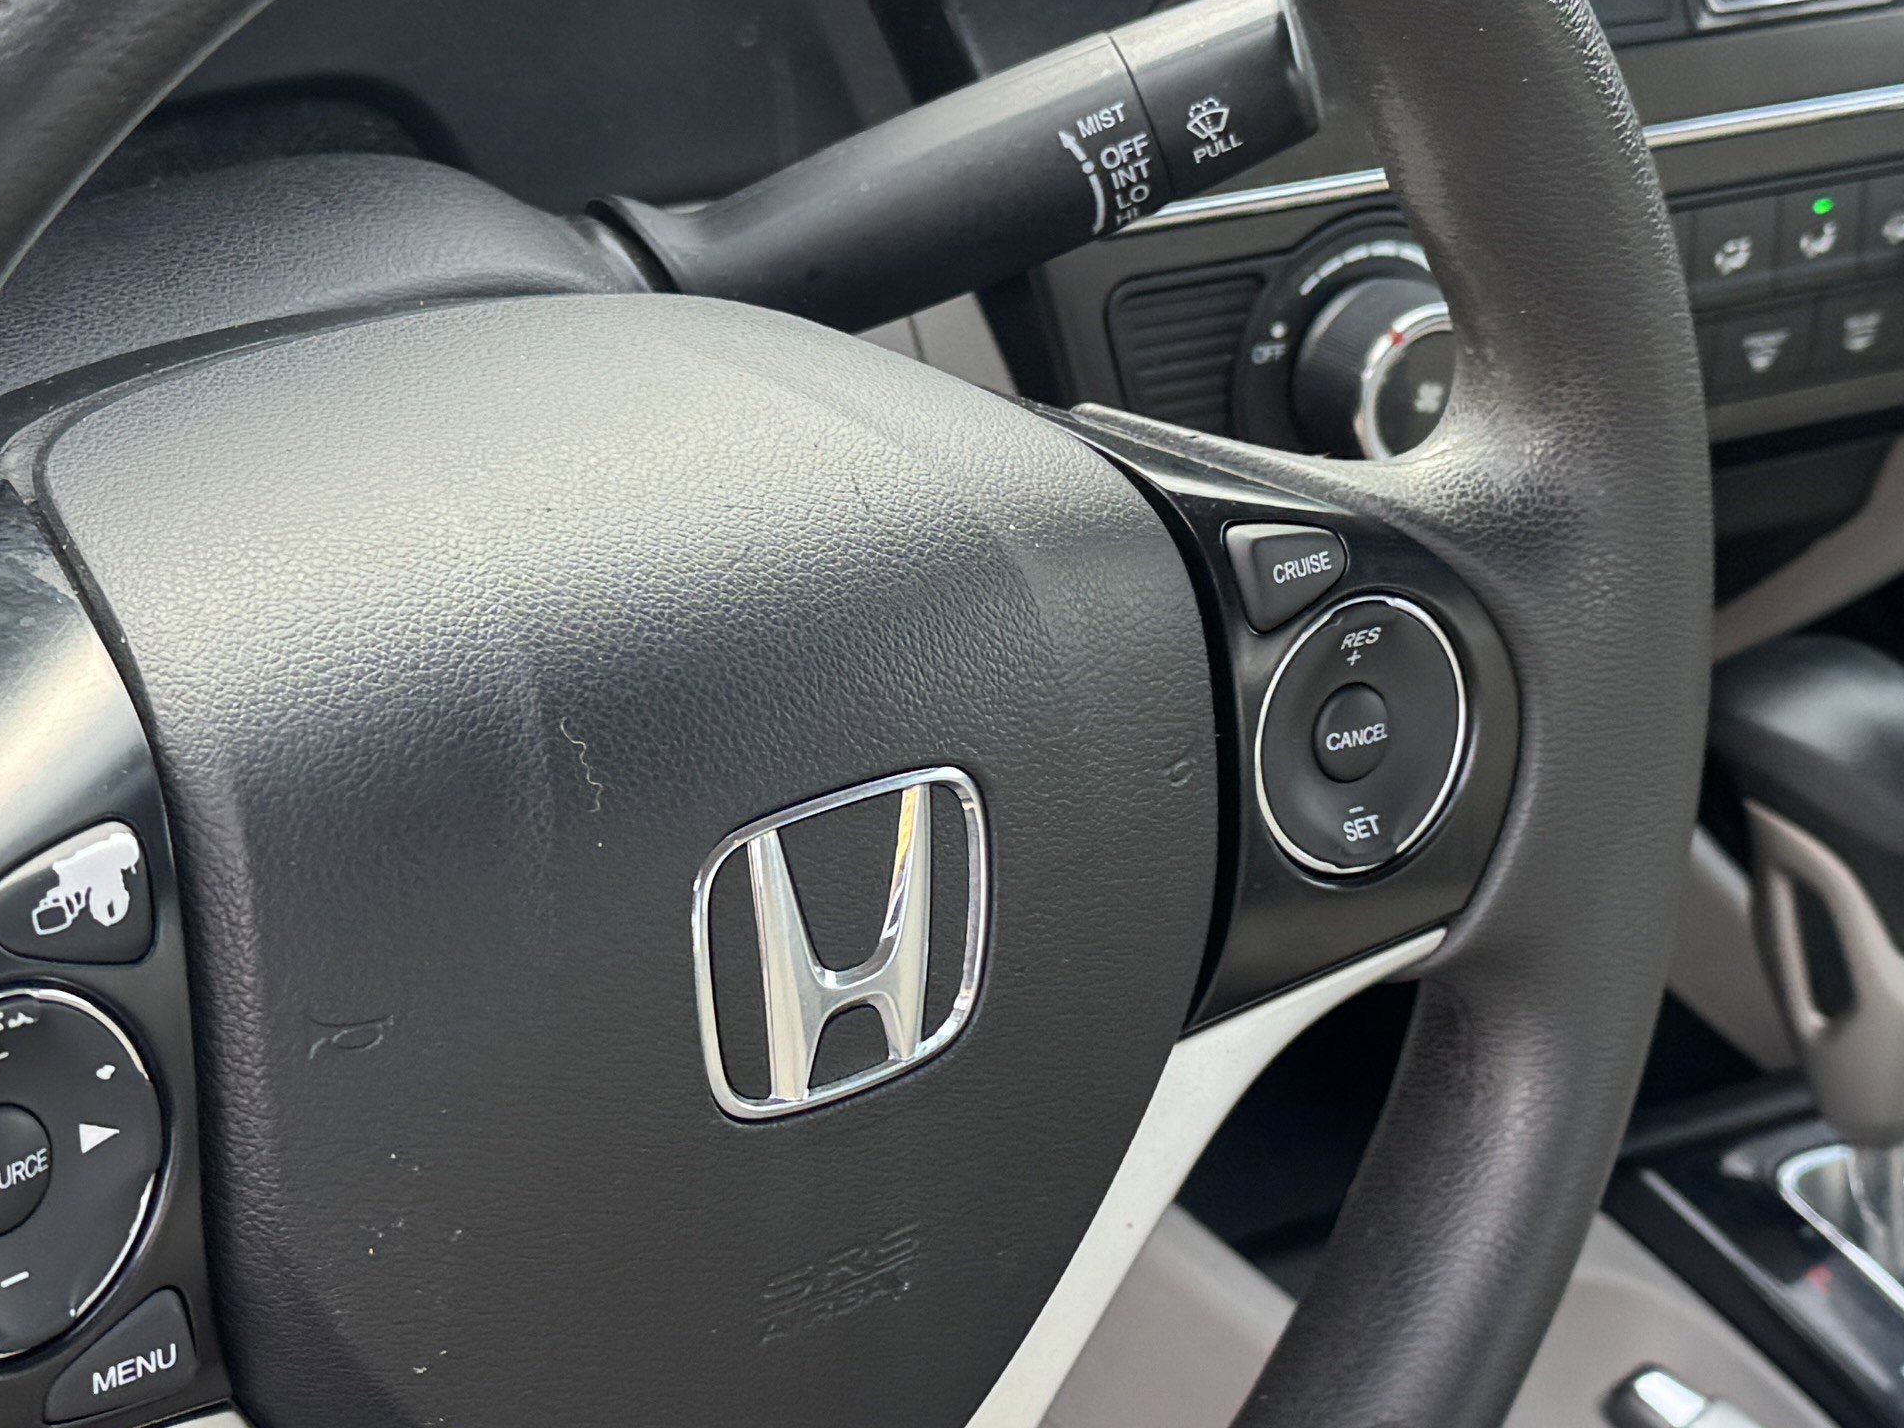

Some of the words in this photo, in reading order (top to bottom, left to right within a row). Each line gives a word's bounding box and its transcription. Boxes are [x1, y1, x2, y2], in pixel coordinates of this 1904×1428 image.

[1076, 101, 1126, 139] MIST
[1100, 132, 1149, 170] OFF
[1193, 133, 1245, 164] PULL
[1110, 158, 1151, 190] INT
[1115, 184, 1150, 210] LO
[1251, 342, 1287, 365] OFF
[1272, 551, 1332, 584] CRUISE
[1340, 627, 1382, 650] RES
[1325, 723, 1387, 752] CANCEL
[1343, 814, 1379, 842] SET
[92, 1343, 177, 1395] MENU
